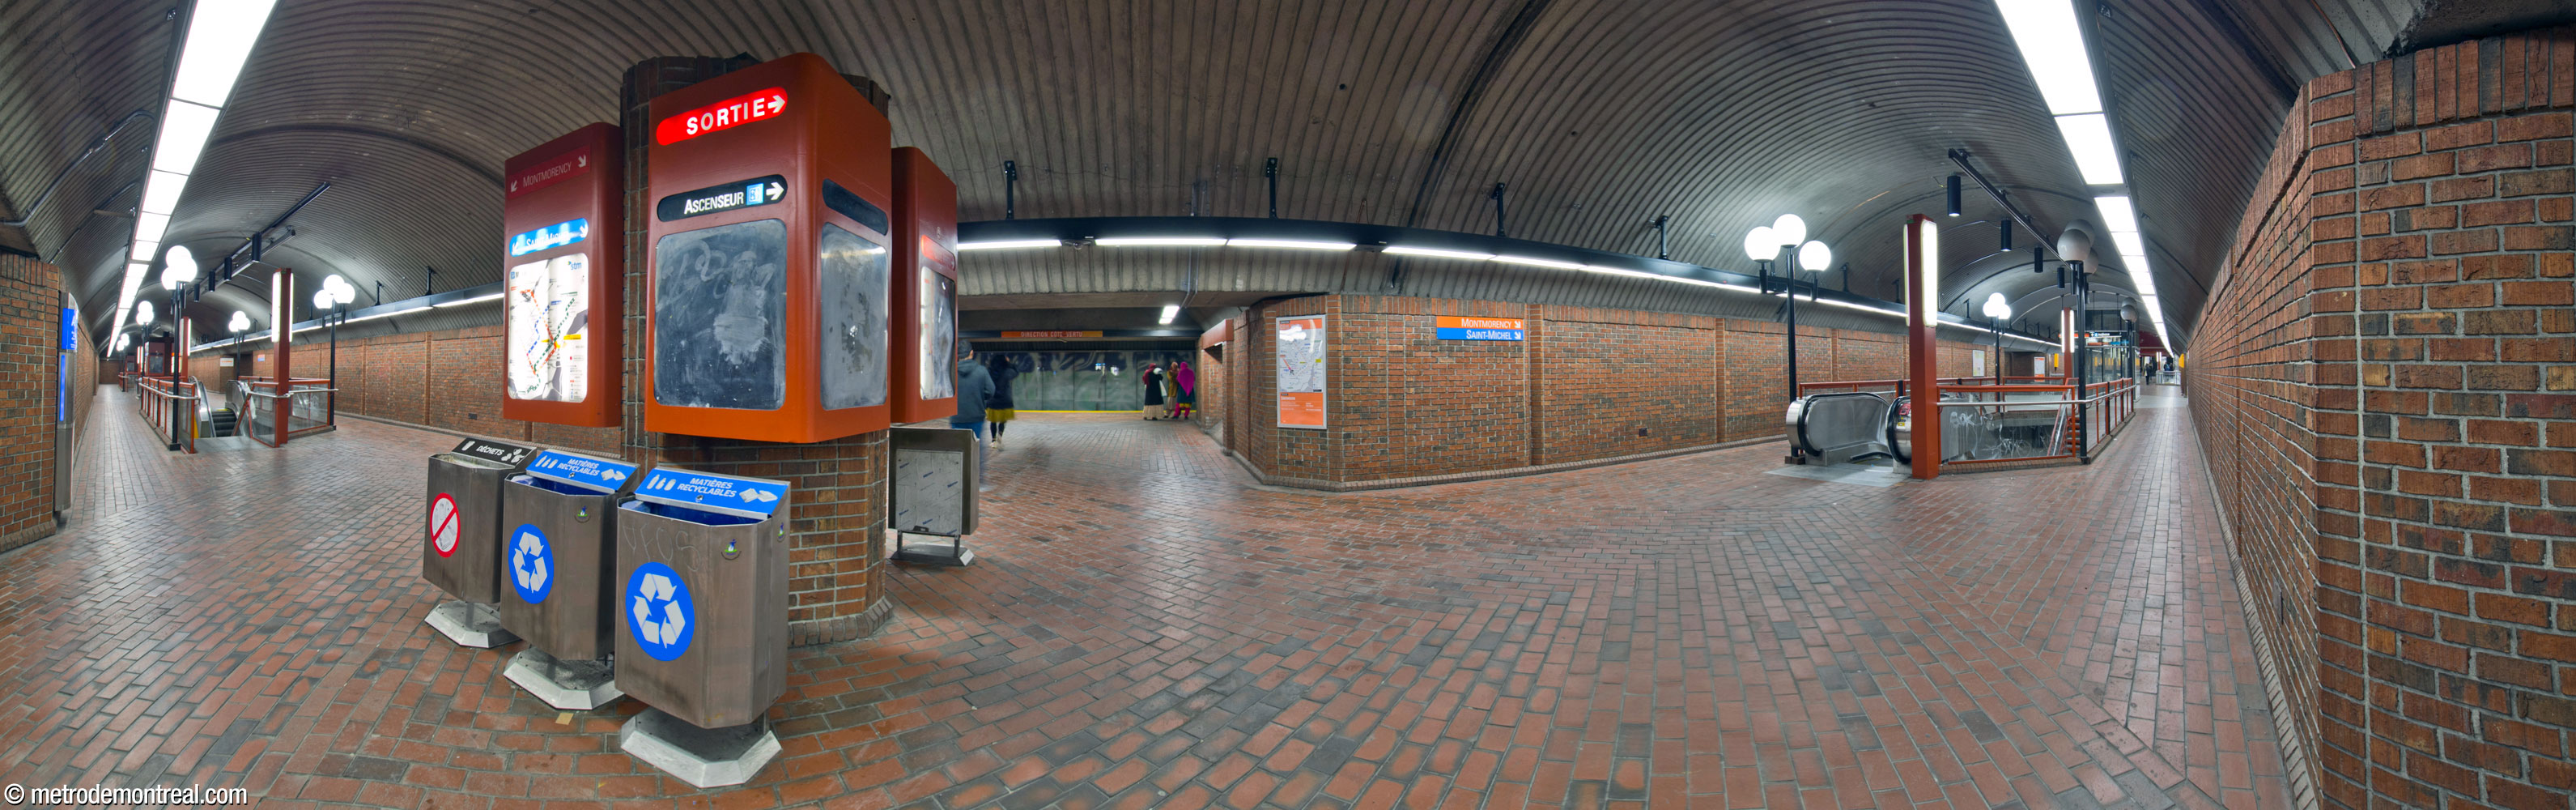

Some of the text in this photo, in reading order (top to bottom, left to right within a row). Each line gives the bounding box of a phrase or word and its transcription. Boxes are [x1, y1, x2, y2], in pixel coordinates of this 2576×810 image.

[687, 98, 765, 134] SORTIE
[523, 162, 572, 188] MONTMORENCY
[684, 191, 744, 215] ASCENSEUR
[1461, 318, 1512, 328] MONTMORENCY
[1466, 330, 1512, 339] SAINT-MICHEL
[475, 445, 505, 456] DÉCHETS
[557, 463, 601, 476] RECYCLABLES
[567, 458, 600, 470] MATIÈRES
[690, 477, 734, 489] MATIÈRES
[677, 483, 738, 498] RECYCLABLES
